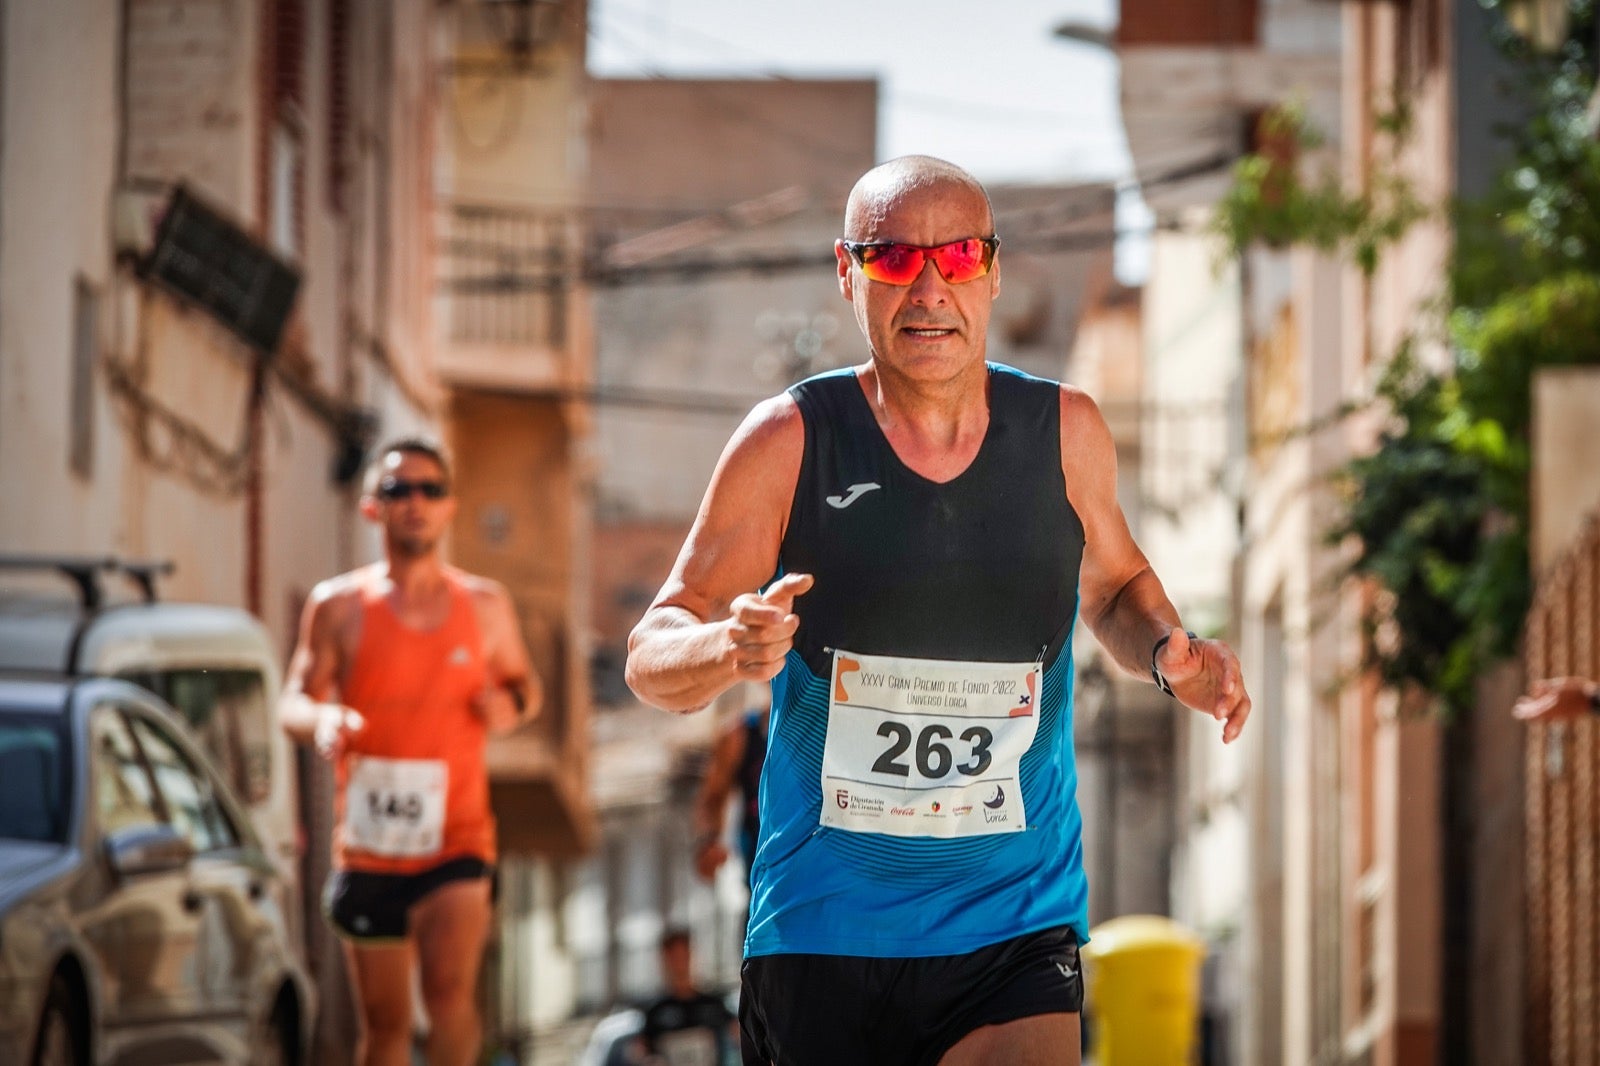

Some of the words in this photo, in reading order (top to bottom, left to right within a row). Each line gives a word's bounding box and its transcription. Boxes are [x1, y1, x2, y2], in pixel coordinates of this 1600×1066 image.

[860, 671, 885, 687] XXXV
[992, 680, 1017, 695] 2022
[871, 720, 994, 780] 263
